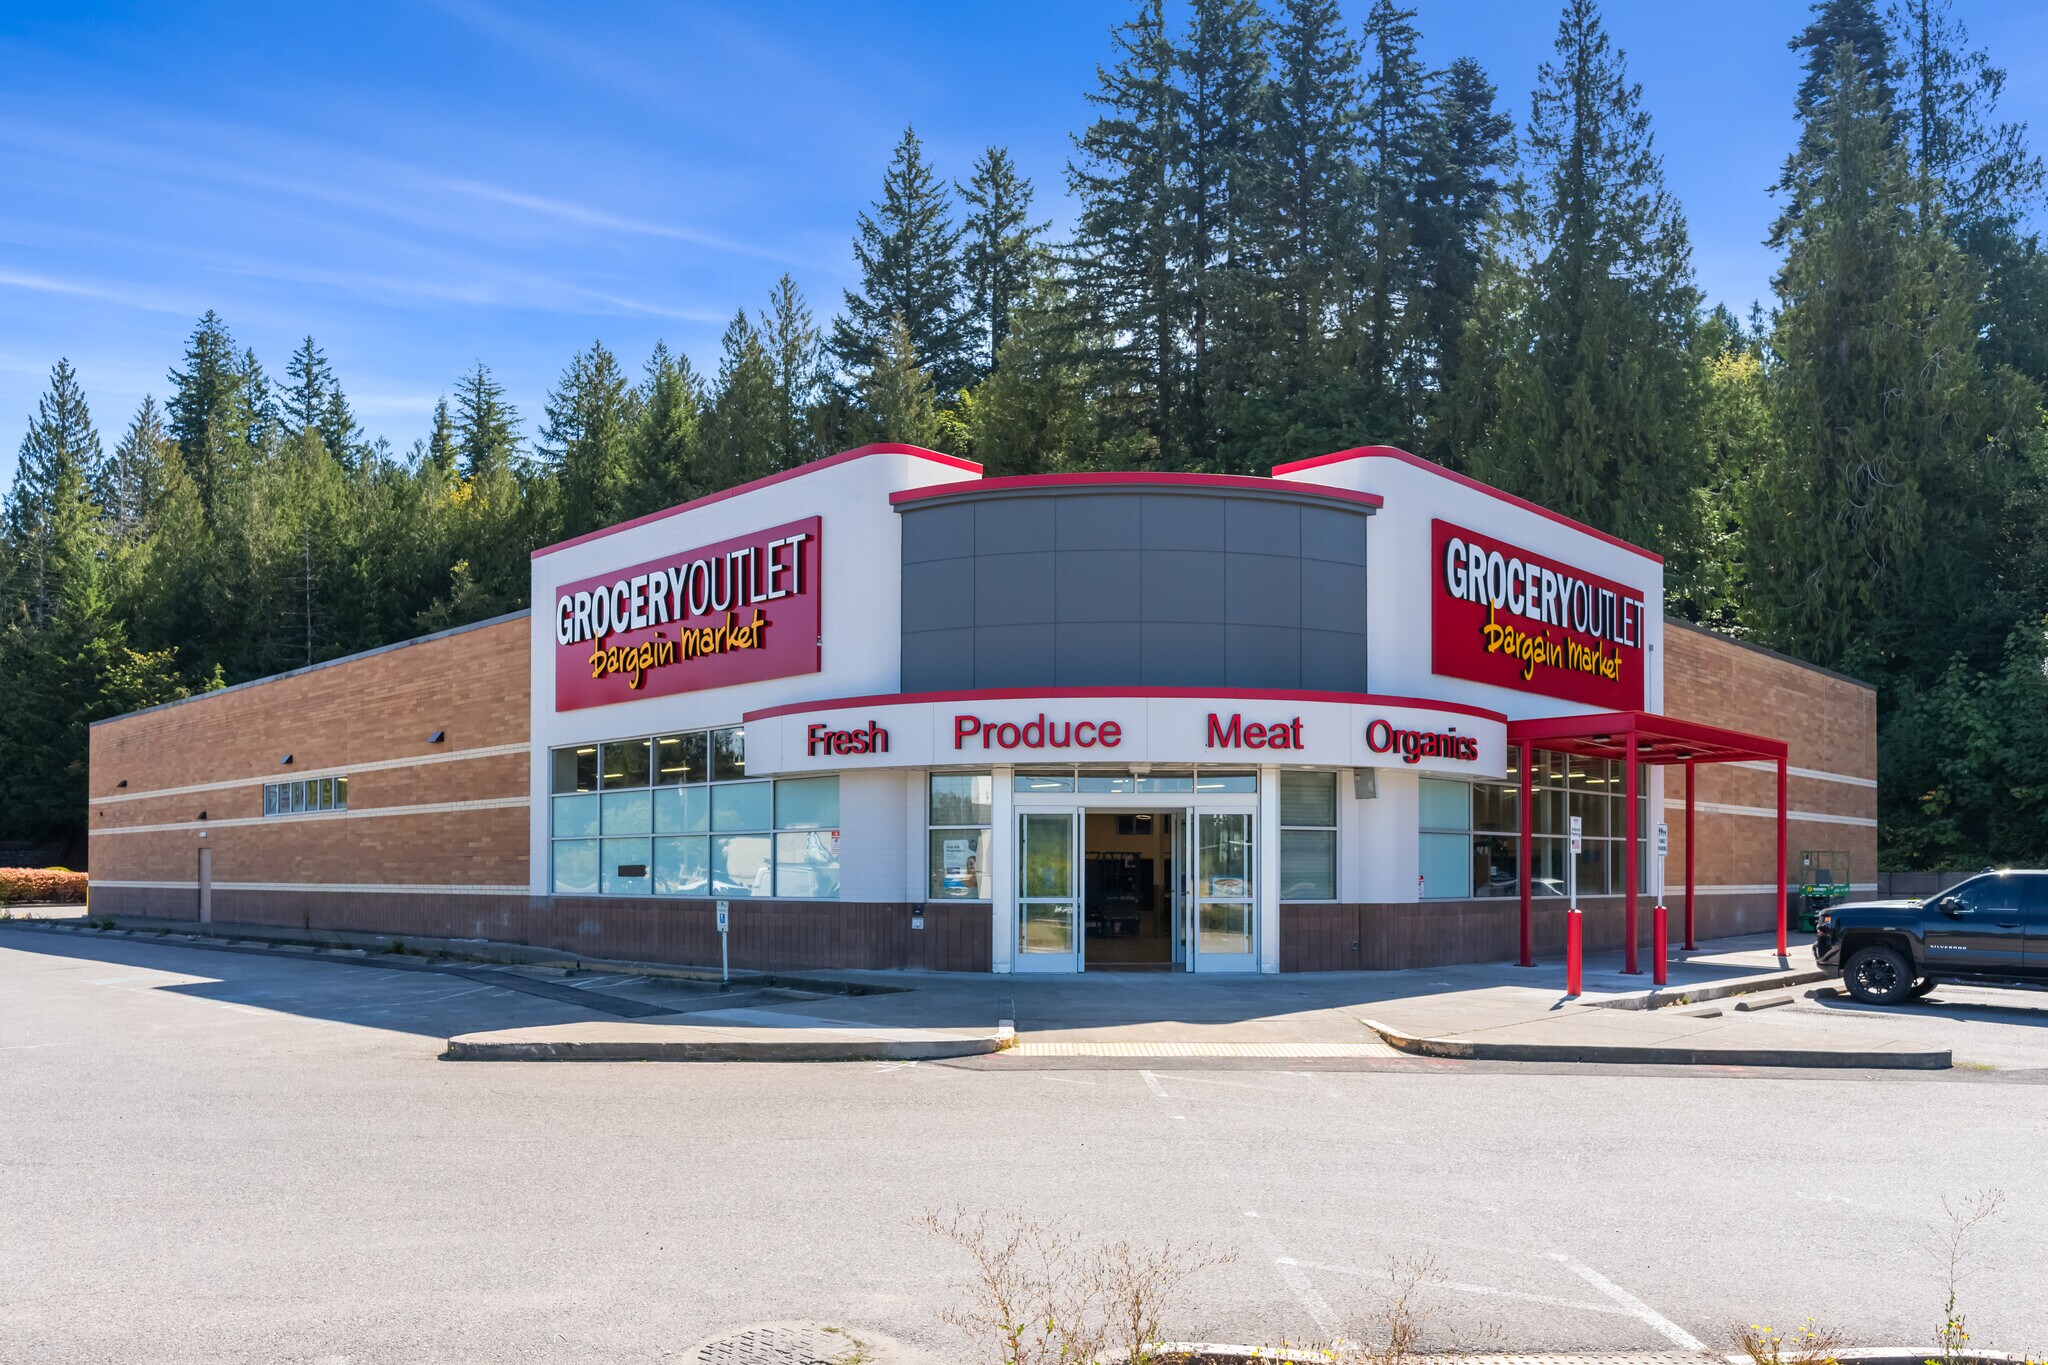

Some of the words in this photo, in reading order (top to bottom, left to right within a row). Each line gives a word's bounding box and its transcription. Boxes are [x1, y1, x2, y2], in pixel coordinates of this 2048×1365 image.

[588, 628, 674, 690] bargain
[681, 608, 765, 660] market
[1483, 597, 1562, 681] bargain
[1567, 636, 1622, 682] market
[807, 720, 889, 757] Fresh
[954, 713, 1122, 750] Produce
[1207, 713, 1304, 750] Meat
[1366, 718, 1479, 764] Organics
